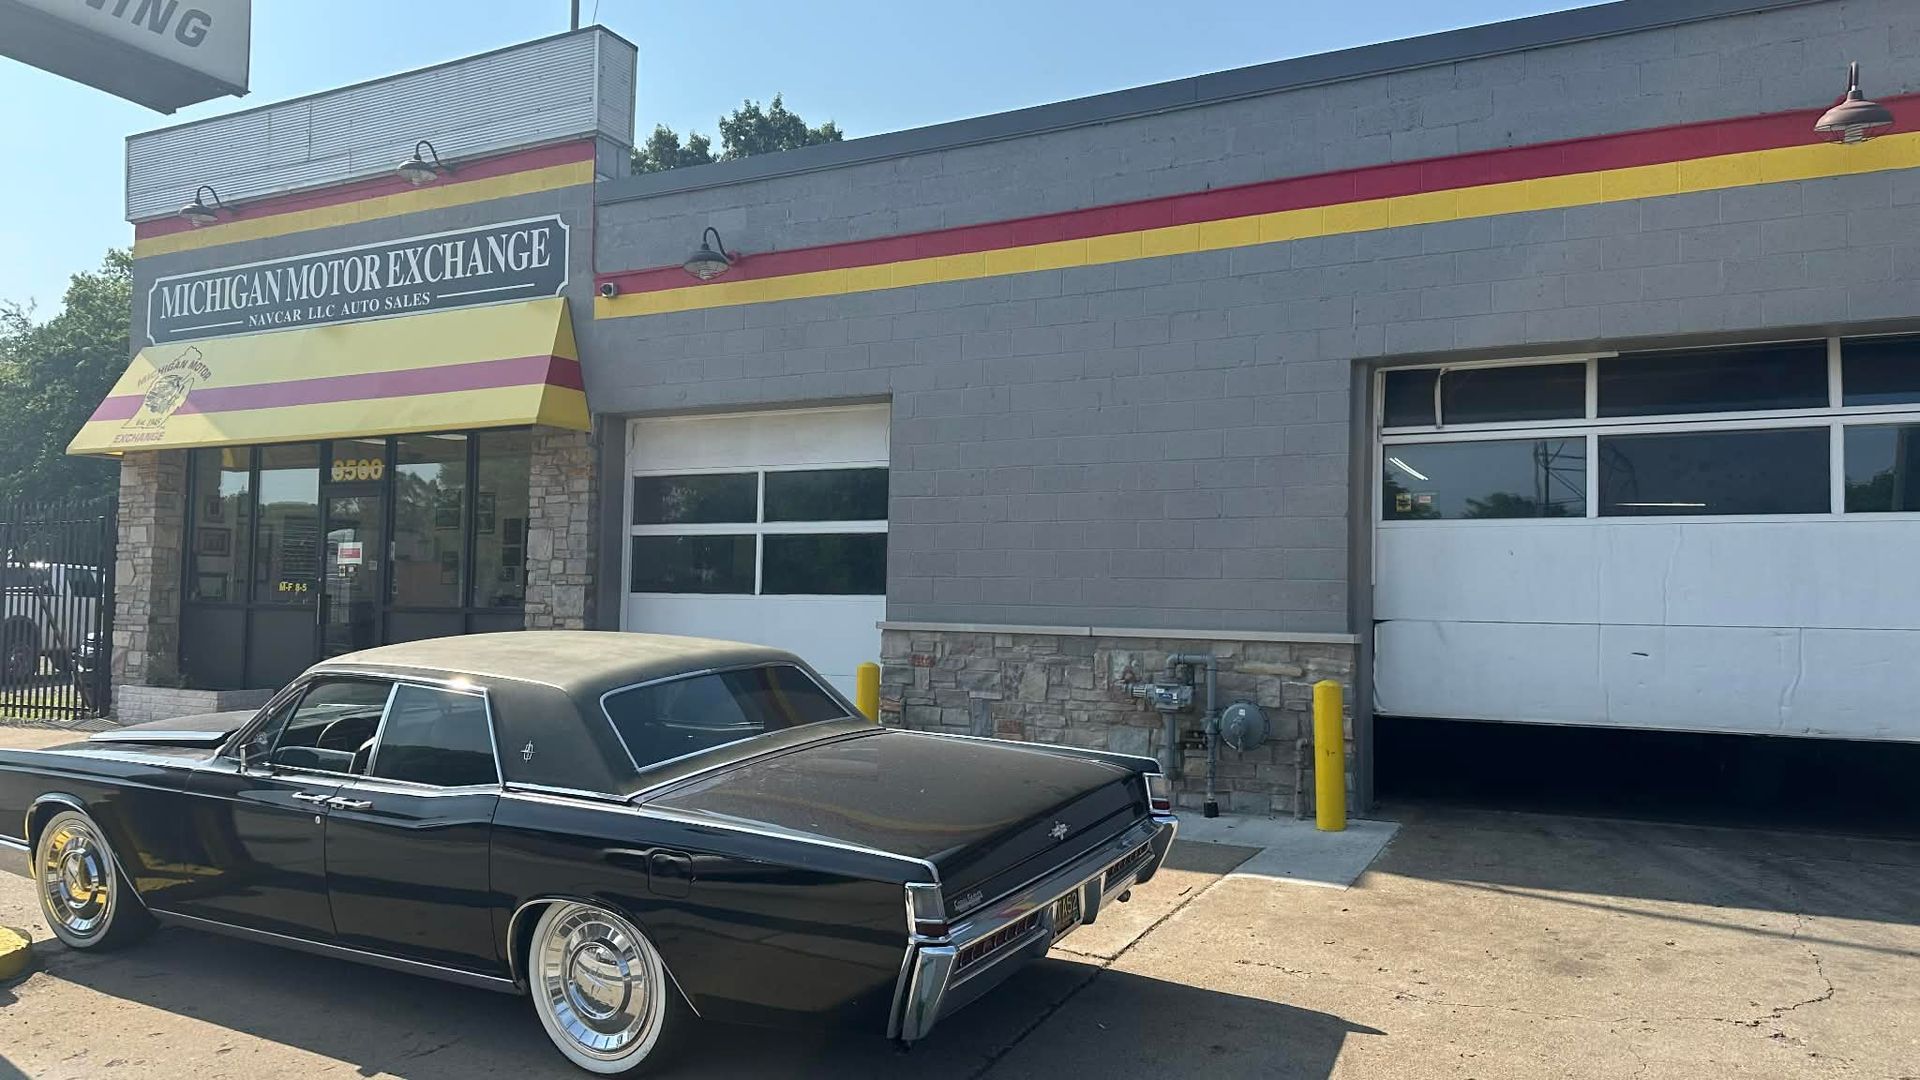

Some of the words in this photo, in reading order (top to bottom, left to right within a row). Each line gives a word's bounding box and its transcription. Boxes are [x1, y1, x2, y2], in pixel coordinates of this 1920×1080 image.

[160, 269, 282, 319] MICHIGAN
[285, 254, 382, 302] MOTOR
[386, 227, 550, 288] EXCHANGE
[249, 308, 301, 327] NAVCAR
[308, 304, 335, 320] LLC
[341, 298, 380, 316] AUTO
[384, 291, 431, 310] SALES
[188, 359, 212, 381] MOTOR
[113, 431, 165, 443] EXCHANGE
[279, 581, 293, 592] M-F
